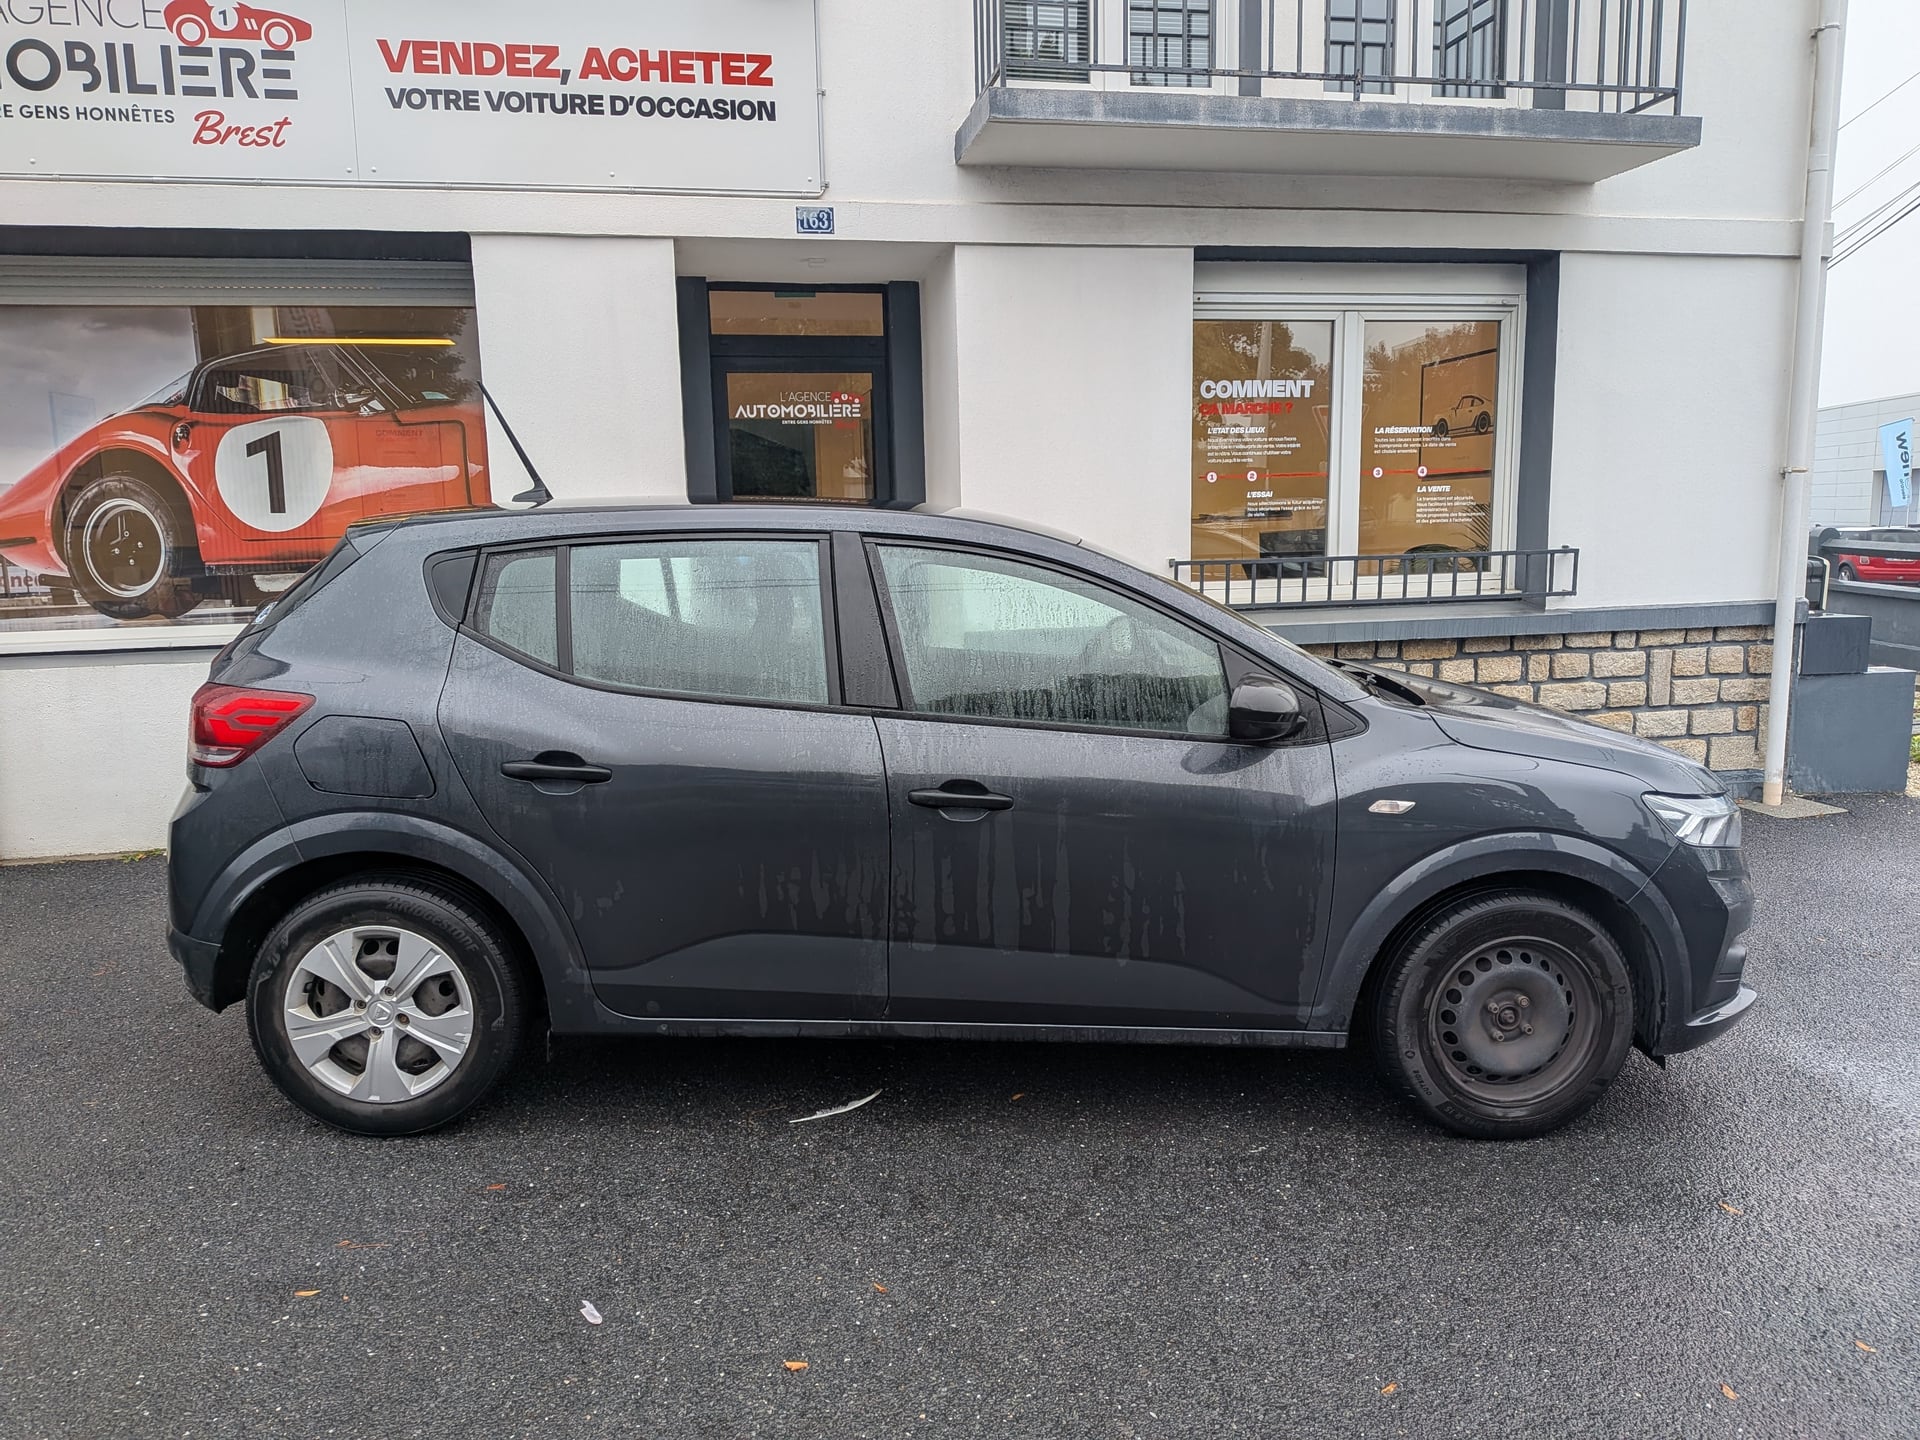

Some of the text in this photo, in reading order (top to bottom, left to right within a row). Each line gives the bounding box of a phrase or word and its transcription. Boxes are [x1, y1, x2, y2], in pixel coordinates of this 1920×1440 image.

[218, 9, 228, 26] 1
[0, 38, 299, 100] OBILIERE
[376, 39, 774, 86] VENDEZ, ACHETEZ
[0, 103, 175, 124] E GENS HONNÊTES
[385, 87, 776, 121] VOTRE VOITURE D'OCCASION
[192, 110, 292, 147] Brest
[803, 210, 829, 229] 163
[780, 391, 831, 402] L'AGENCE
[1200, 380, 1315, 399] COMMENT
[1385, 425, 1433, 434] RÉSERVATION
[246, 430, 286, 513] 1
[1428, 485, 1451, 493] VENTE
